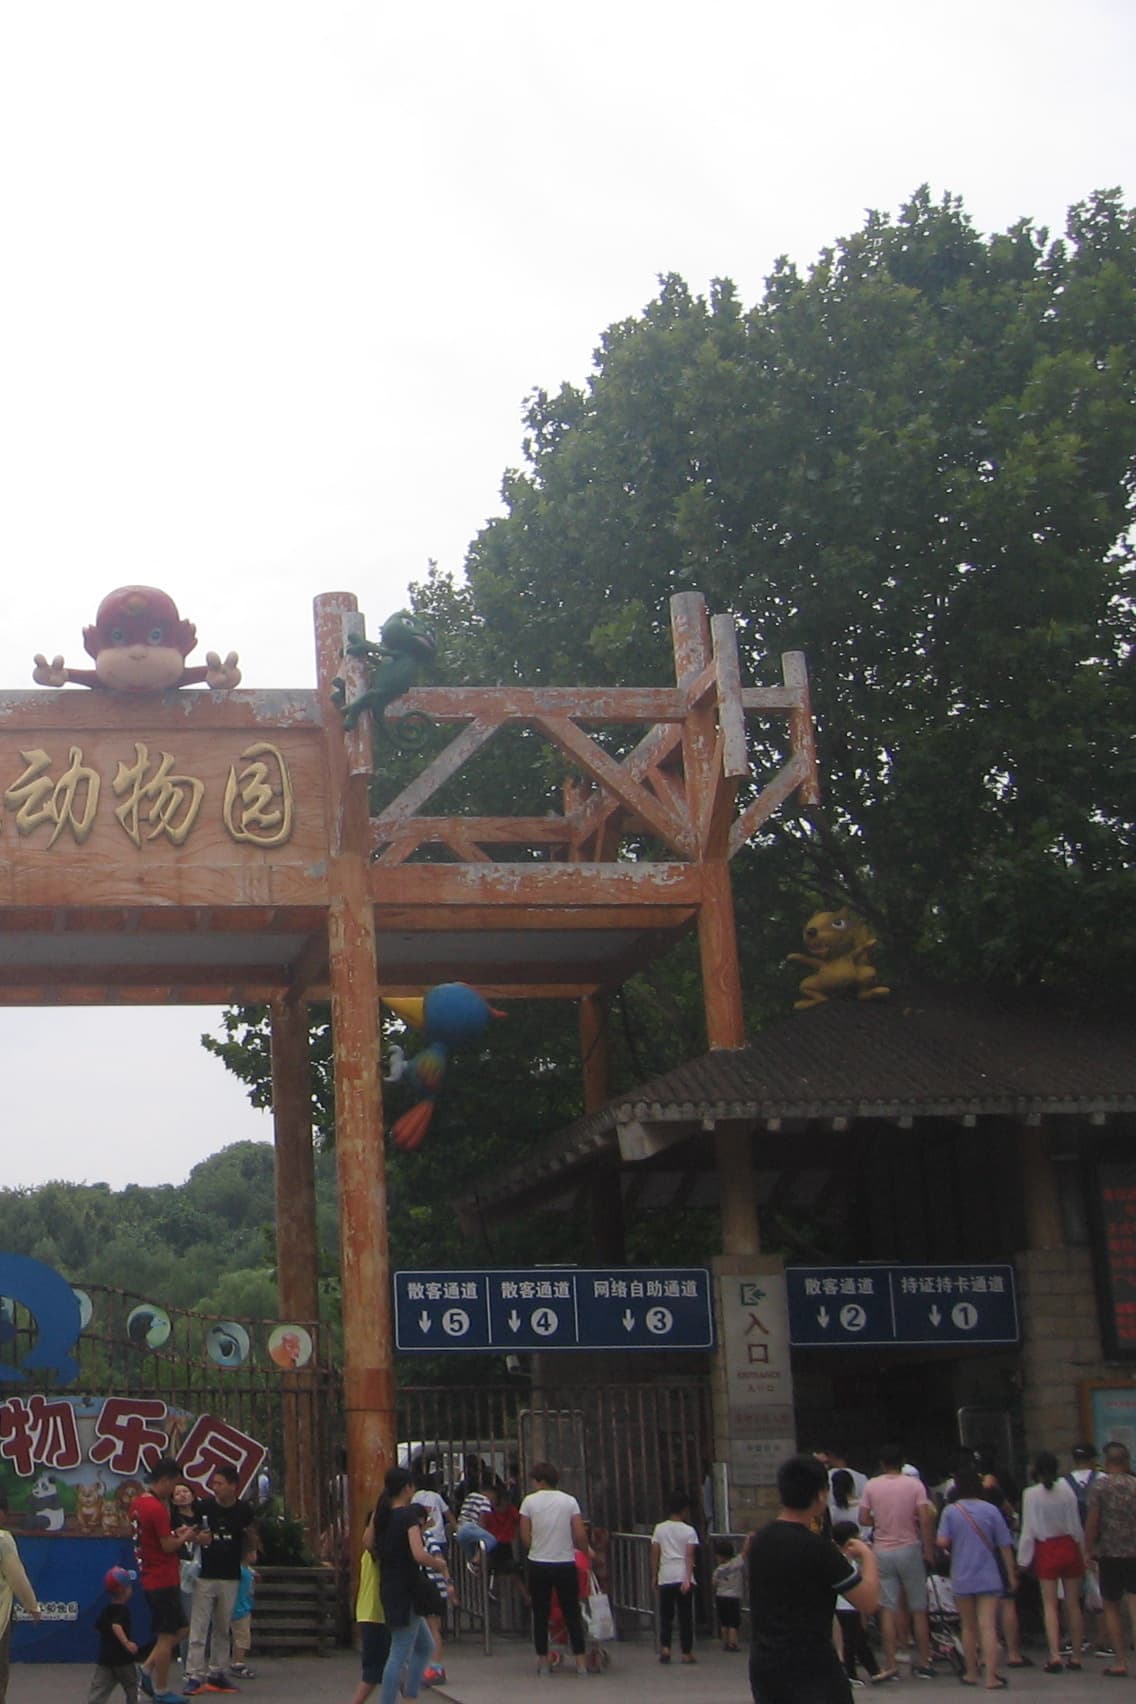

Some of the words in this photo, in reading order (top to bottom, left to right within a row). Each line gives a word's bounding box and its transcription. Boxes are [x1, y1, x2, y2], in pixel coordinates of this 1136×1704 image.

[407, 1281, 479, 1300] 散客通道
[500, 1280, 570, 1300] 散客通道
[593, 1279, 699, 1299] 网络自助通道
[804, 1276, 875, 1296] 散客通道
[900, 1275, 1005, 1295] 持证持卡通道
[448, 1311, 464, 1334] 5
[534, 1310, 553, 1333] 4
[651, 1309, 668, 1332] 3
[844, 1306, 862, 1329] 2
[958, 1305, 972, 1327] 1
[744, 1313, 770, 1364] 入口
